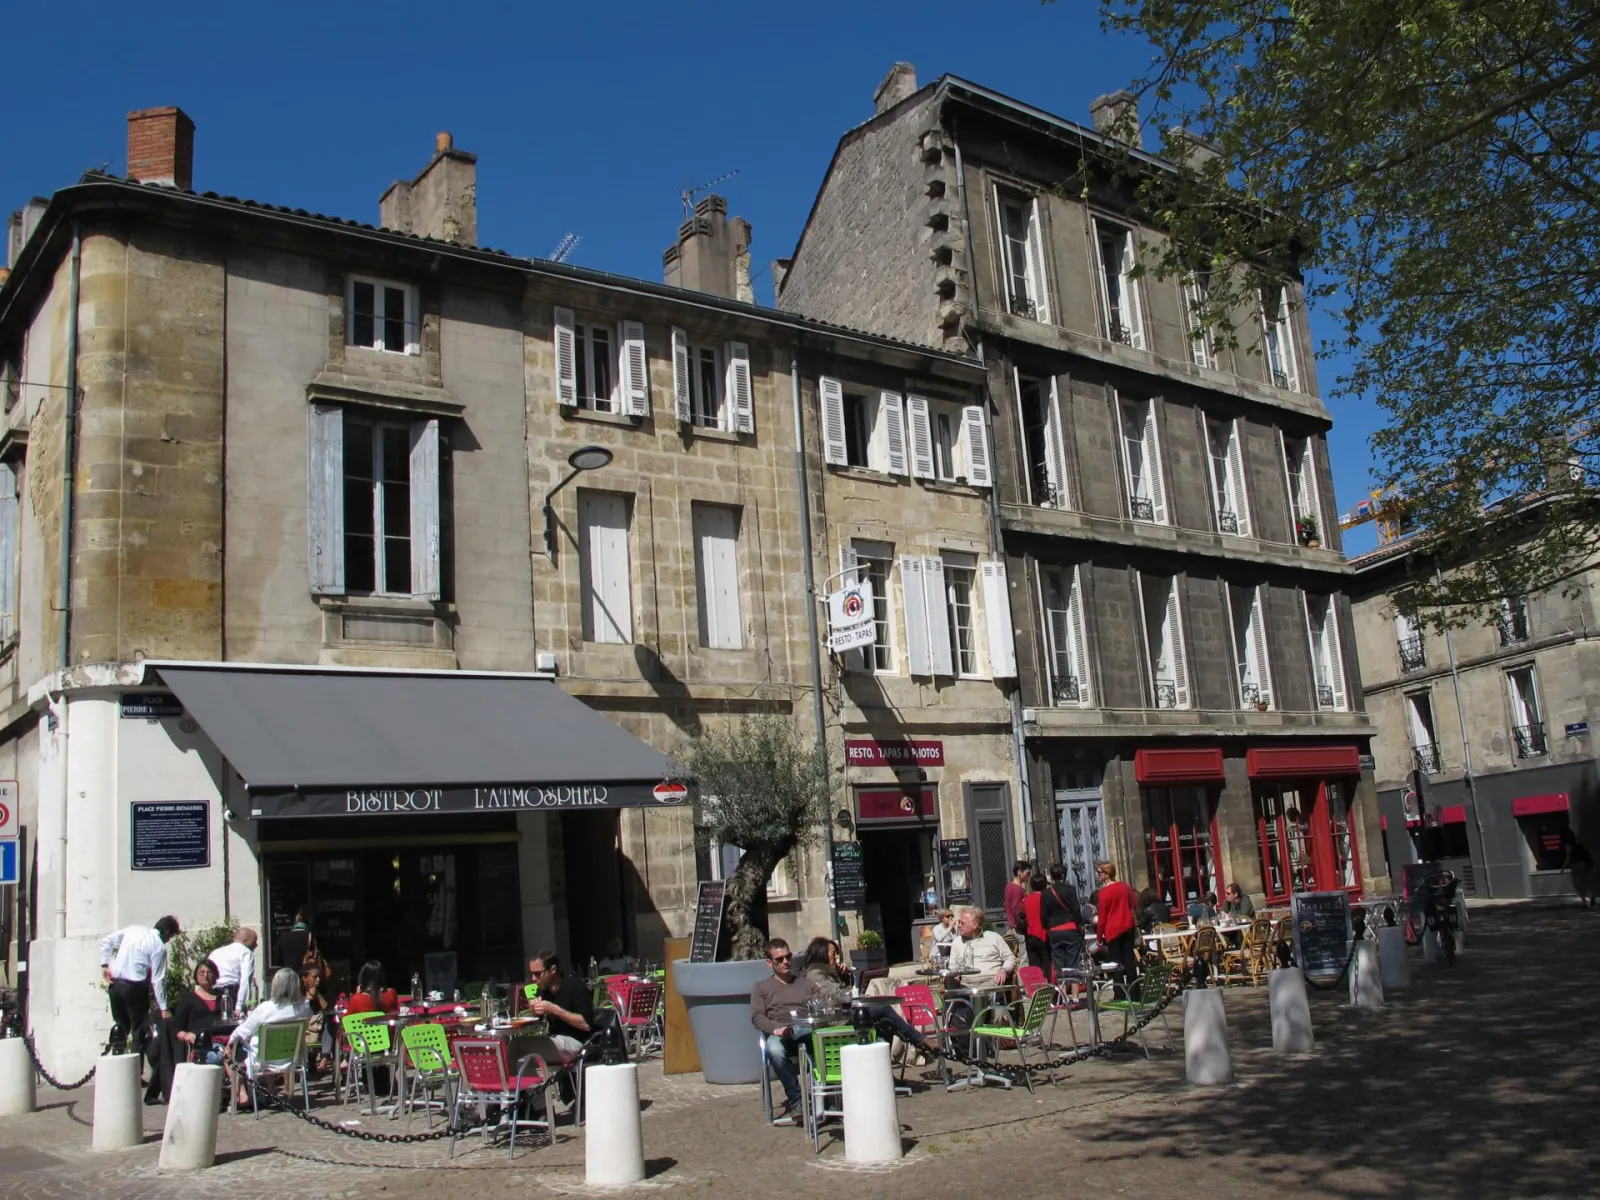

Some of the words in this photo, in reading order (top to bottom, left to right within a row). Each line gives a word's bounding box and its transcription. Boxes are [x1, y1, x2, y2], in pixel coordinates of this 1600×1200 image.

[835, 634, 852, 645] RESTO
[855, 629, 873, 639] TAPAS
[878, 747, 902, 759] TAPAS
[903, 748, 909, 758] &
[911, 748, 940, 759] PHOTOS
[346, 790, 443, 812] BISTROT
